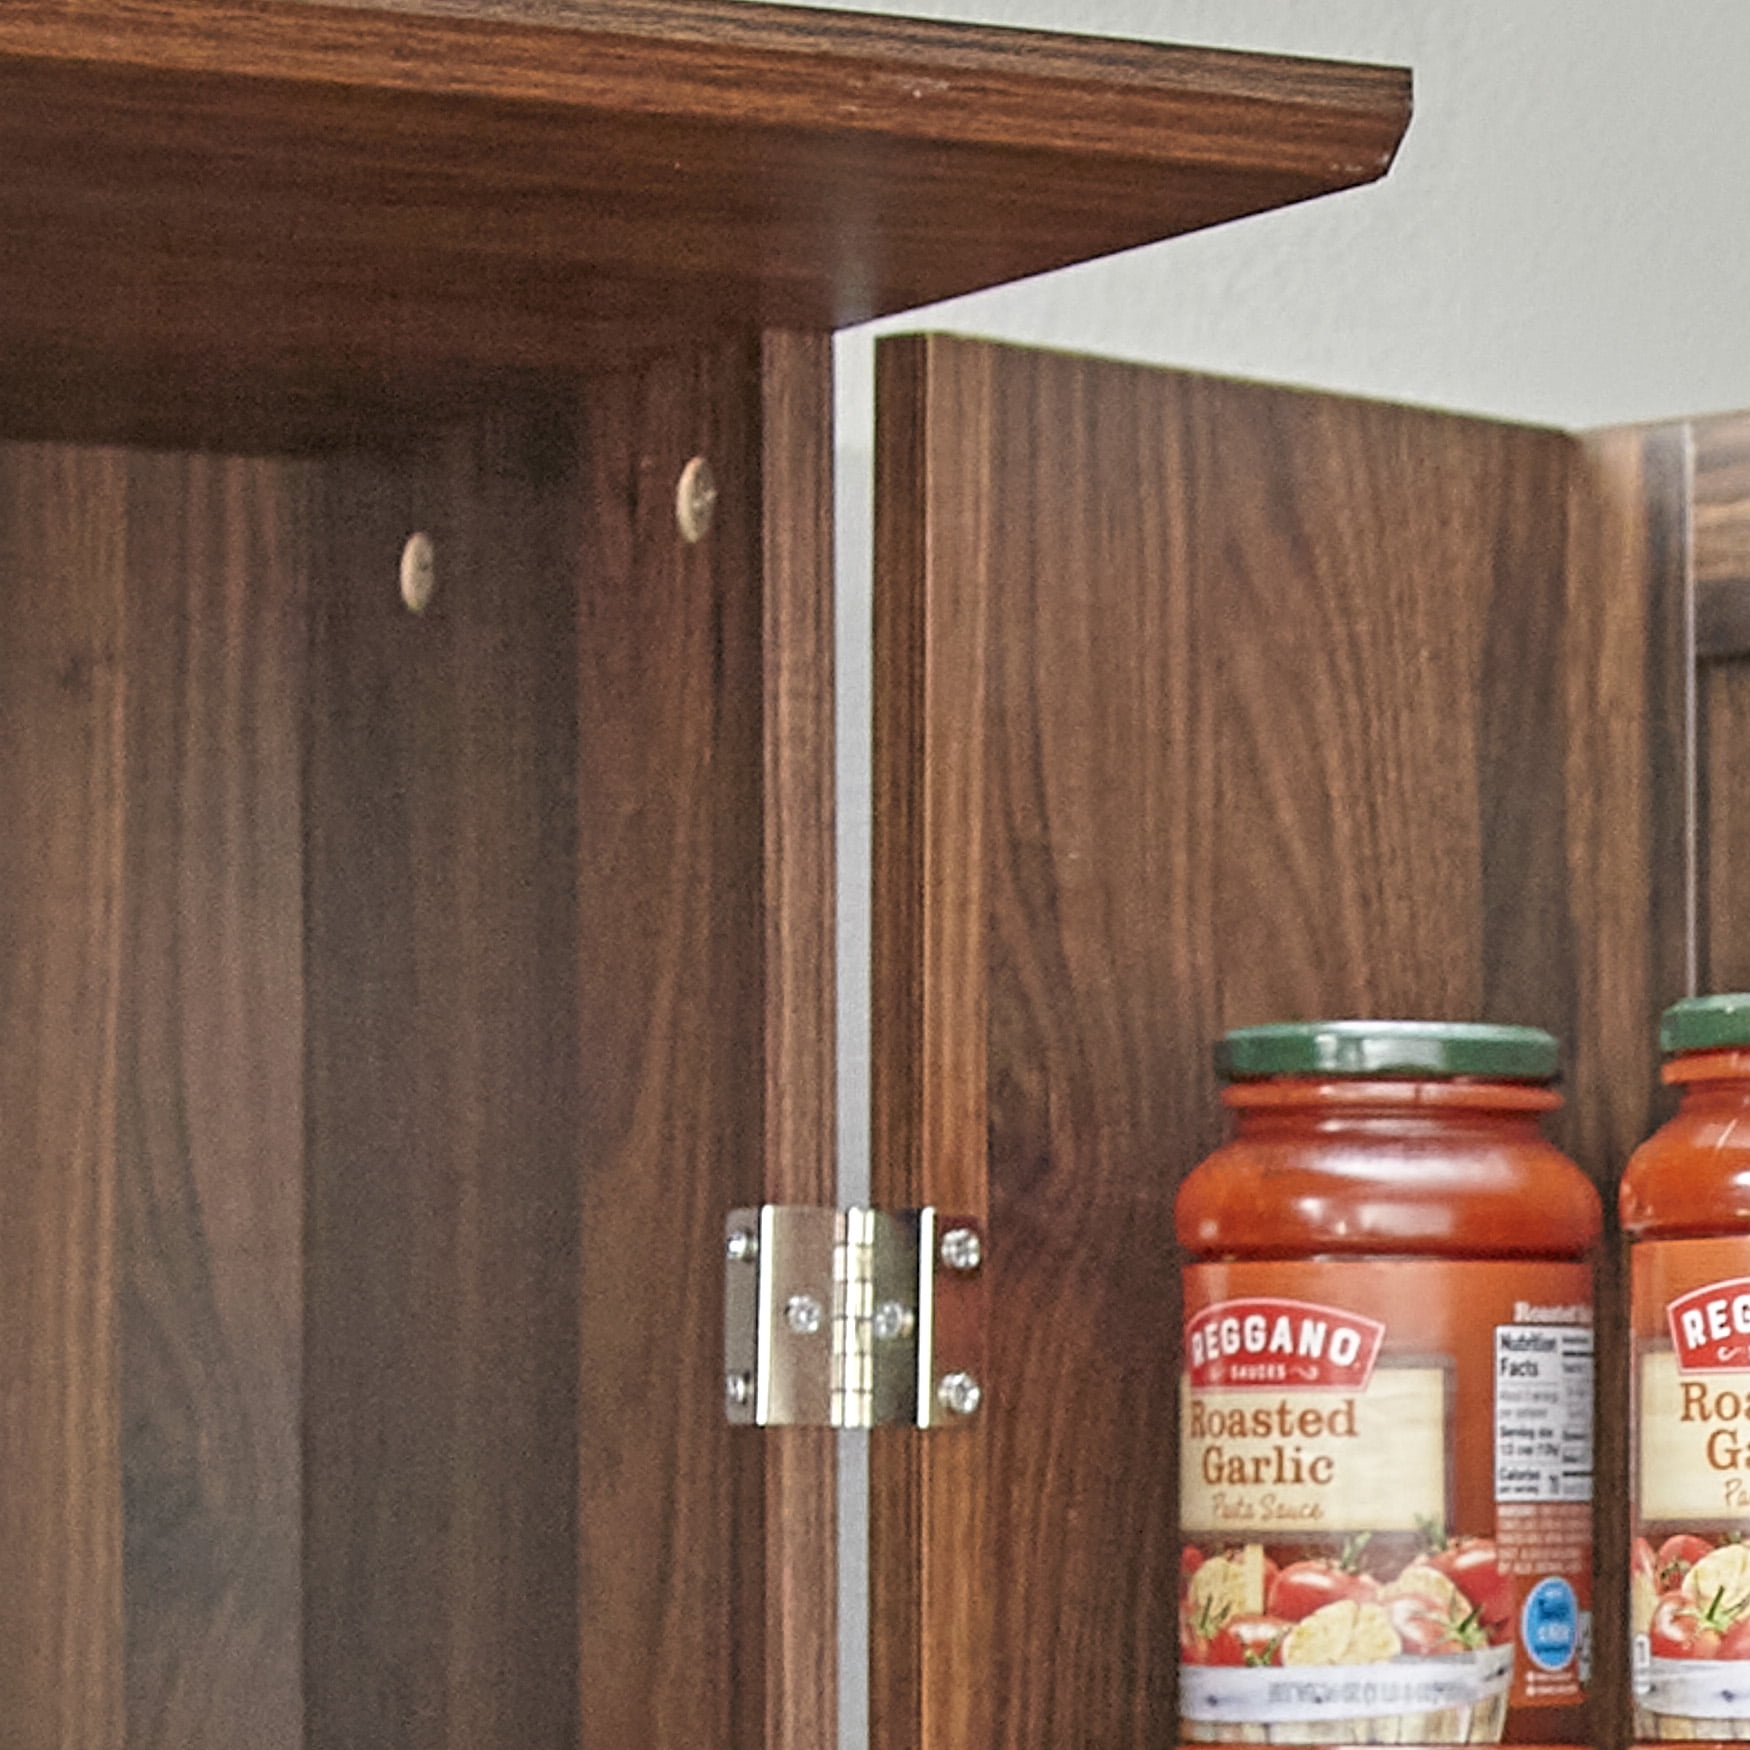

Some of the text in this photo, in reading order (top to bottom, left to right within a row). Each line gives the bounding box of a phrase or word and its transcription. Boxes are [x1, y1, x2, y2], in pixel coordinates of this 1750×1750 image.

[1191, 1314, 1361, 1368] REGGANO
[1230, 1364, 1286, 1381] SAUCES
[1190, 1400, 1358, 1440] Roasted
[1202, 1445, 1334, 1486] Garlic
[1261, 1496, 1324, 1522] Sauce
